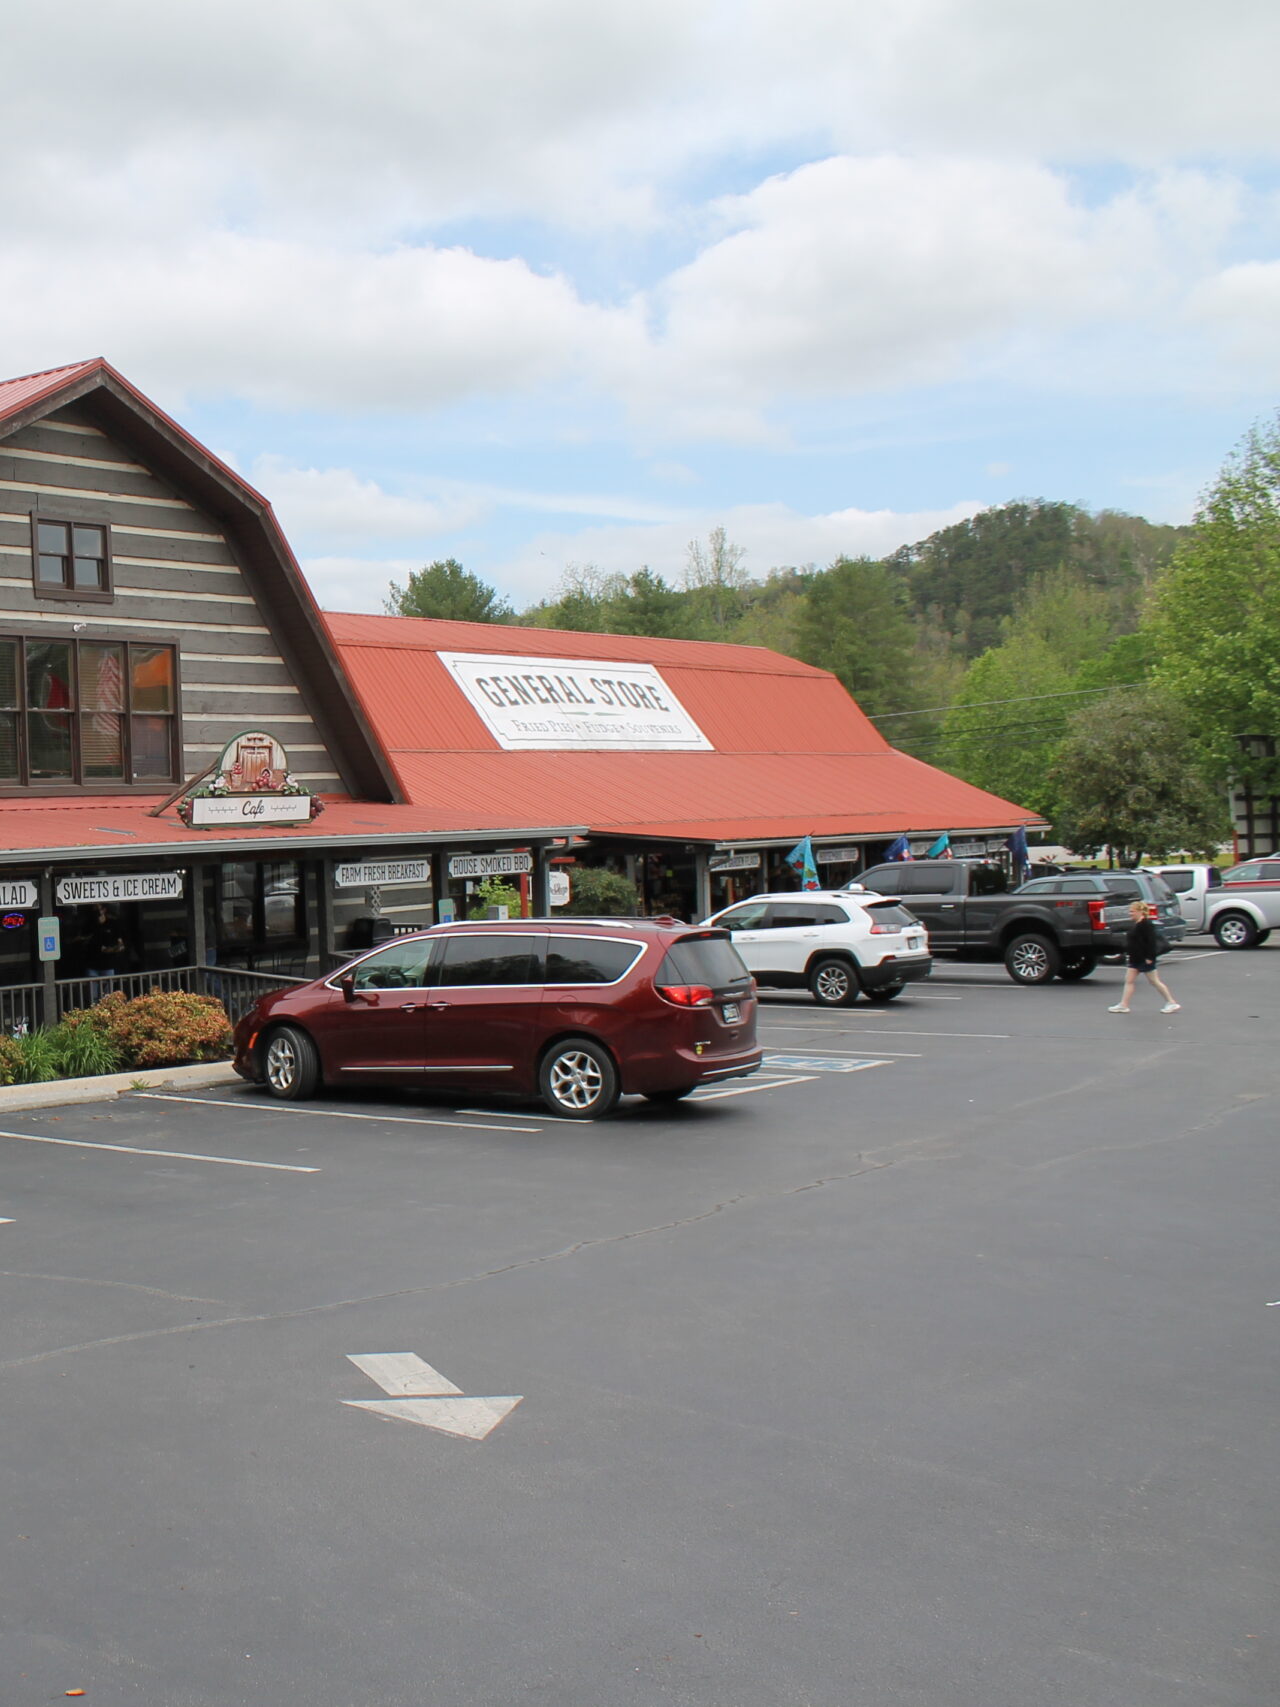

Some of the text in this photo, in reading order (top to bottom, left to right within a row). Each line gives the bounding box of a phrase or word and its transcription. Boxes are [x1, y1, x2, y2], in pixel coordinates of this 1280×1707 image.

[475, 674, 671, 712] GENERAL STORE
[511, 719, 550, 733] FRIED
[548, 720, 575, 733] PIES
[582, 721, 621, 734] FUDGE
[242, 800, 265, 819] Cafe
[341, 863, 425, 883] FARM FRESH BREAKFAST
[453, 854, 529, 875] HOUSE SMOKED BBQ
[63, 877, 177, 900] SWEETS & ICE CREAM
[2, 916, 25, 926] OPEN
